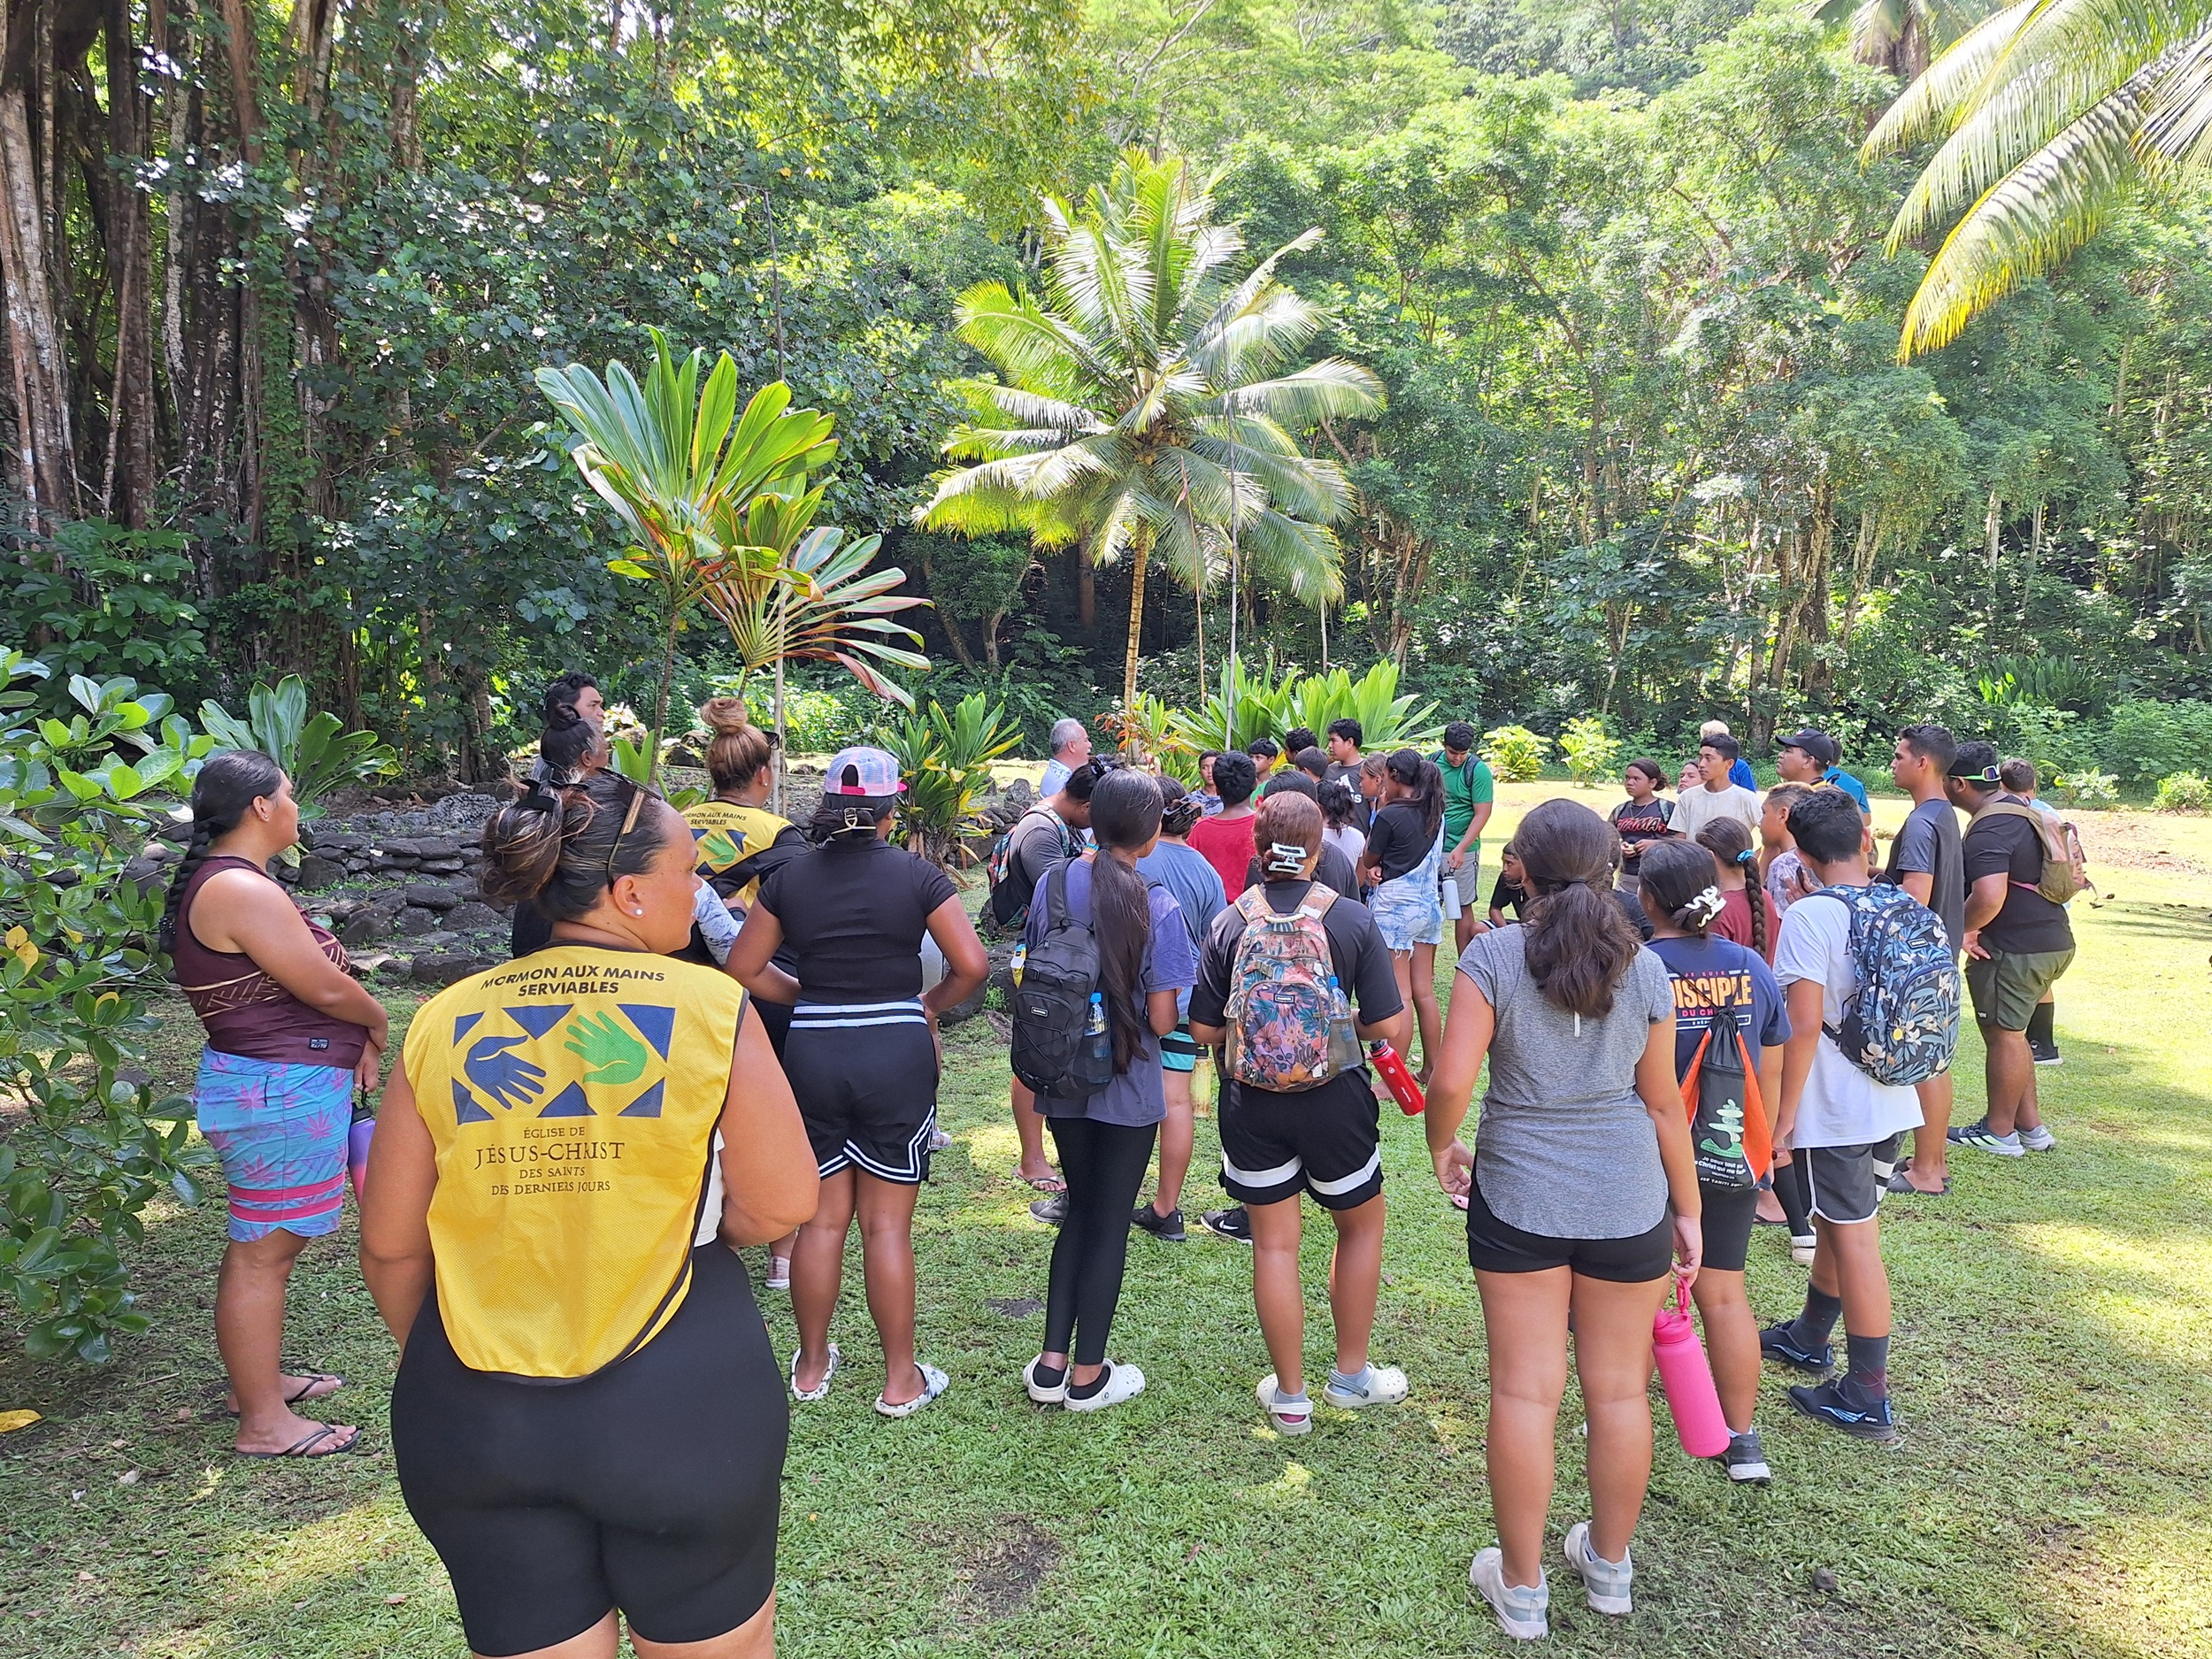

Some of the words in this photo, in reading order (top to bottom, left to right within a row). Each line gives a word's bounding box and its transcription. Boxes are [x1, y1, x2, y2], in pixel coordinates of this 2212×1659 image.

[722, 812, 748, 821] MAINS
[480, 966, 557, 990] MORMON
[561, 964, 601, 978] AUX
[603, 967, 665, 981] MAINS
[518, 981, 619, 996] SERVIABLES
[1670, 975, 1754, 1009] ISCIPLE
[524, 1126, 565, 1139] ÉGLISE
[569, 1126, 585, 1136] DE
[474, 1141, 625, 1170] JÉSUS-CHRIST
[1698, 1160, 1717, 1170] Christ
[519, 1168, 542, 1179] DES
[548, 1166, 585, 1178] SAINTS
[491, 1185, 509, 1194] DES
[514, 1181, 573, 1194] DERNIERS
[577, 1180, 611, 1194] JOURS
